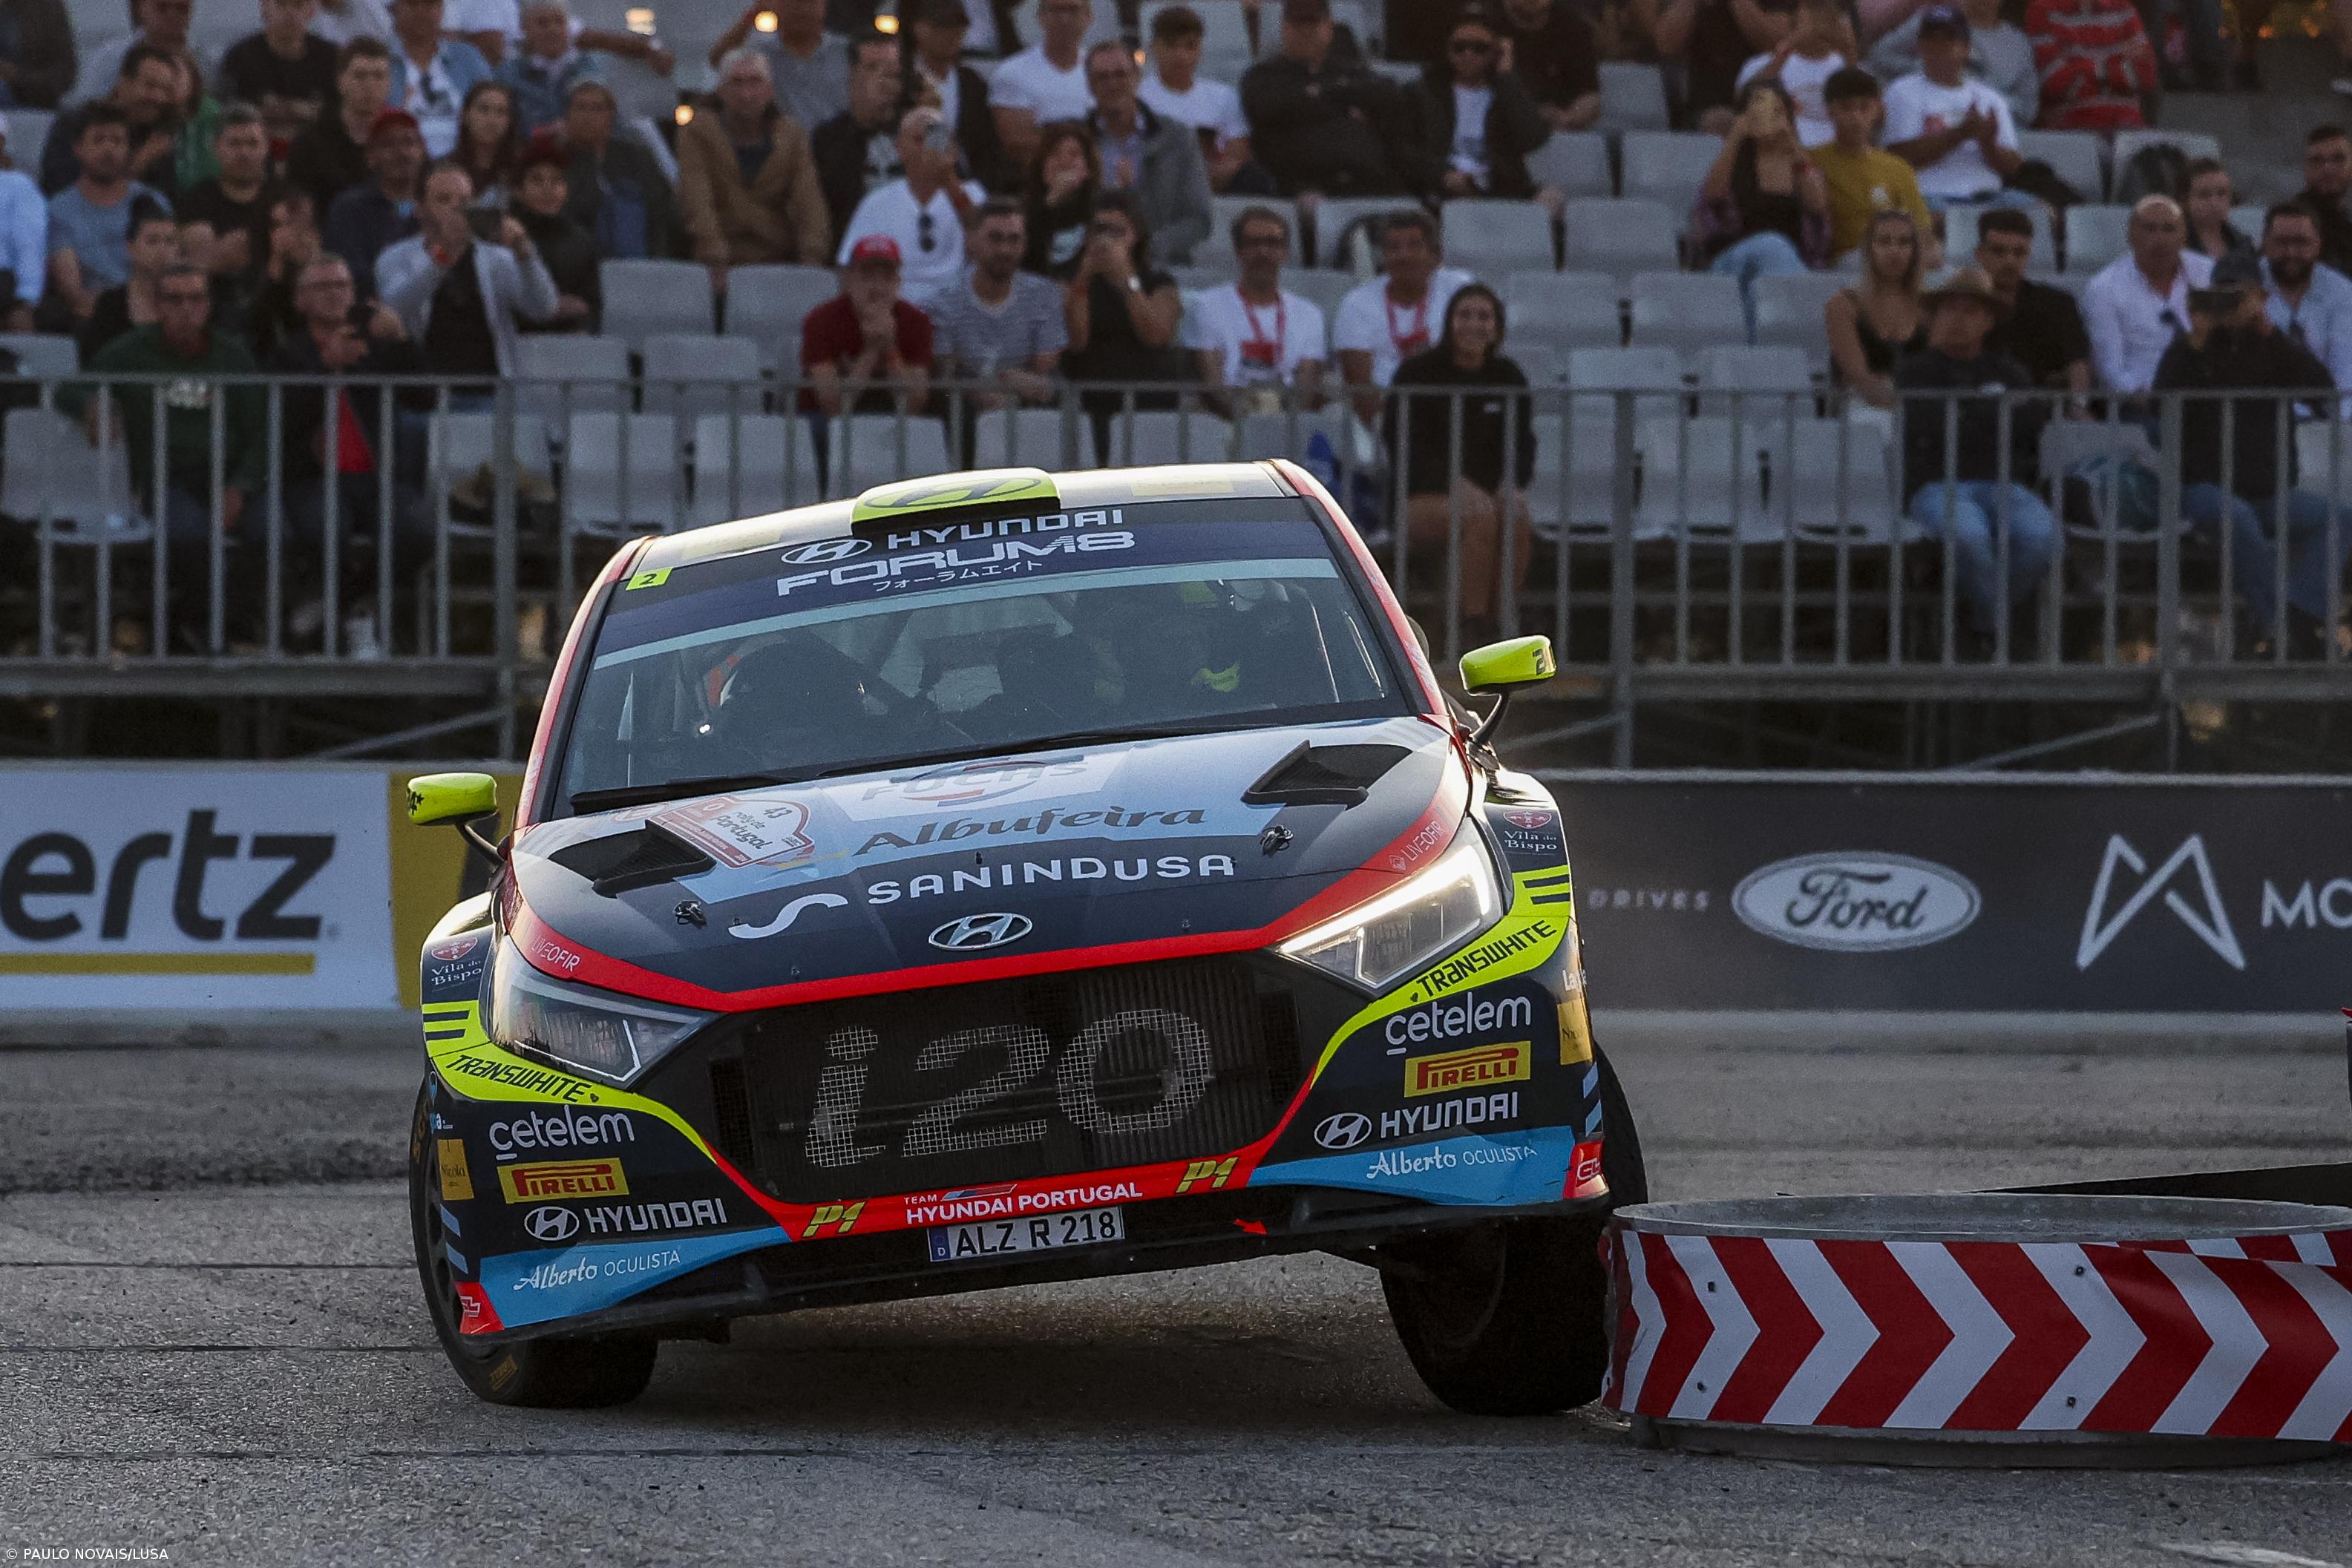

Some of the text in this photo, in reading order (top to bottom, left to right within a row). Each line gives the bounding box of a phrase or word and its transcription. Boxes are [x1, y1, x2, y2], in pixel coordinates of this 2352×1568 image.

[888, 509, 1123, 550] HYUNDAI
[639, 574, 658, 585] 2
[776, 531, 1136, 597] FORUM8
[872, 562, 1043, 592] フォーラムエイト
[710, 815, 773, 850] Portugal
[763, 806, 793, 820] 43
[853, 805, 1206, 857] Albufeira
[1504, 830, 1539, 840] Vila
[1504, 839, 1557, 852] Bispo
[0, 807, 337, 942] ertz
[867, 853, 1235, 905] SANINDUSA
[1786, 868, 1930, 932] Ford
[431, 963, 464, 975] Vila
[431, 968, 482, 985] Bispo
[1386, 991, 1532, 1056] cetelem
[804, 1008, 1213, 1169] i20
[1416, 1047, 1520, 1091] PIRELLI
[488, 1105, 635, 1161] cetelem
[1380, 1092, 1519, 1139] HYUNDAI
[511, 1162, 616, 1197] PIRELLI
[1176, 1156, 1239, 1194] P1
[1366, 1144, 1538, 1180] Alberto OCULISTA
[585, 1198, 728, 1233] HYUNDAI
[903, 1193, 938, 1204] TEAM
[905, 1184, 1144, 1224] HYUNDAI PORTUGAL
[802, 1200, 869, 1239] P1
[956, 1211, 1116, 1257] ALZ R 218
[514, 1249, 681, 1291] Alberto OCULISTA
[937, 1247, 946, 1256] D
